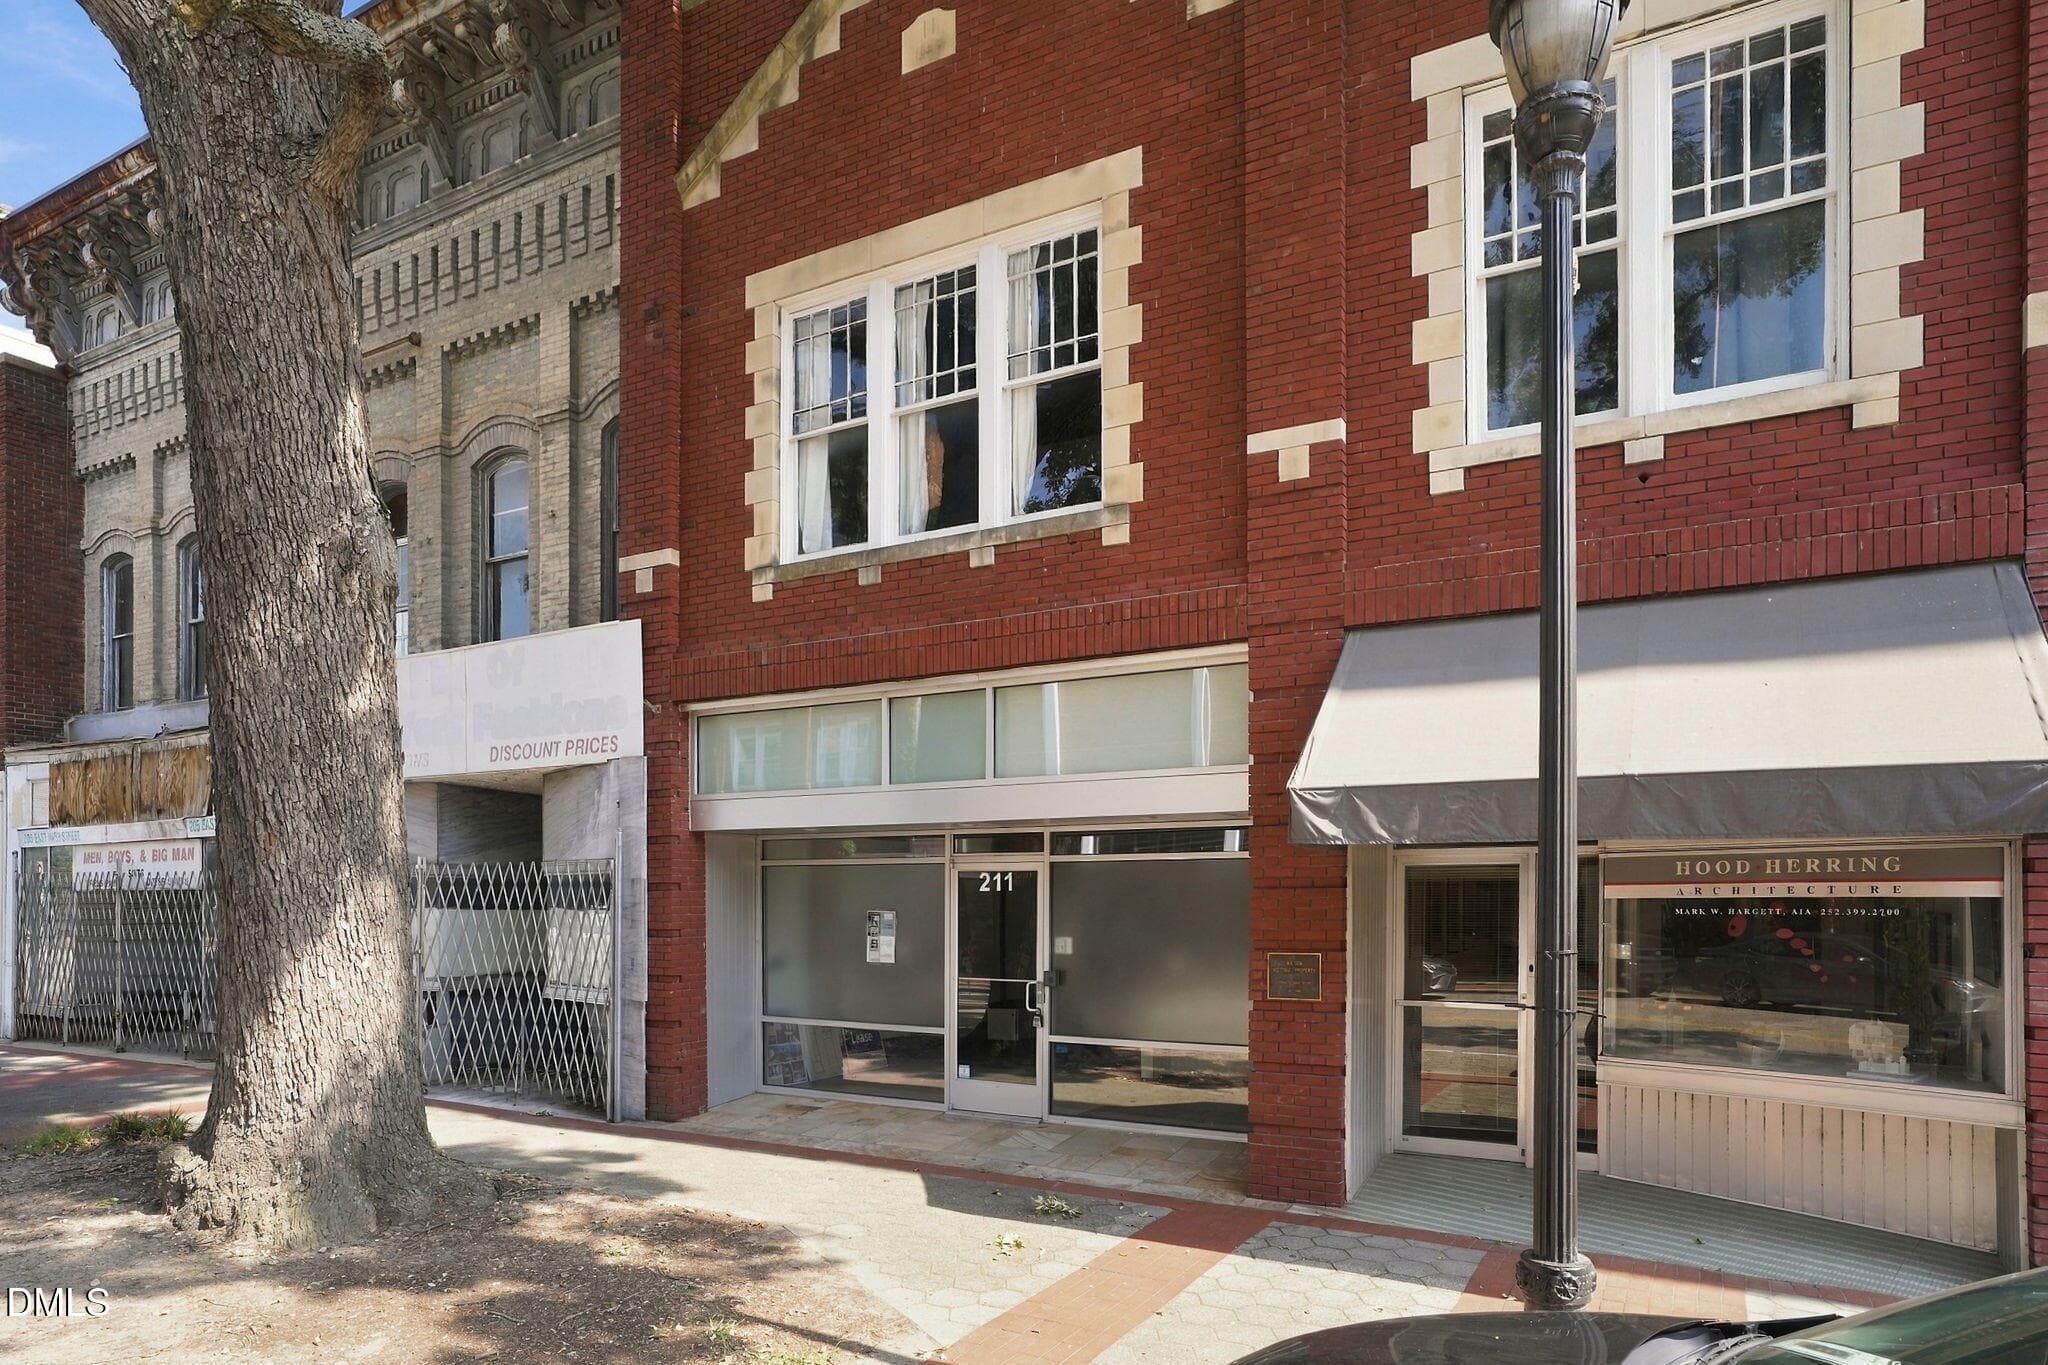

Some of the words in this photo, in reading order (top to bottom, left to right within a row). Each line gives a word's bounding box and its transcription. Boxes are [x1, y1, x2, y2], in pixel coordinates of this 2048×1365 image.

[489, 740, 562, 763] DISCOUNT
[565, 735, 619, 757] PRICES
[201, 818, 215, 830] EAS
[140, 849, 147, 863] &
[152, 848, 168, 861] BIG
[172, 847, 195, 861] MAN
[1676, 860, 1751, 875] HOOD
[1765, 856, 1901, 874] HERRING
[979, 871, 1013, 892] 211
[1676, 885, 1902, 896] ARCHITECTURE
